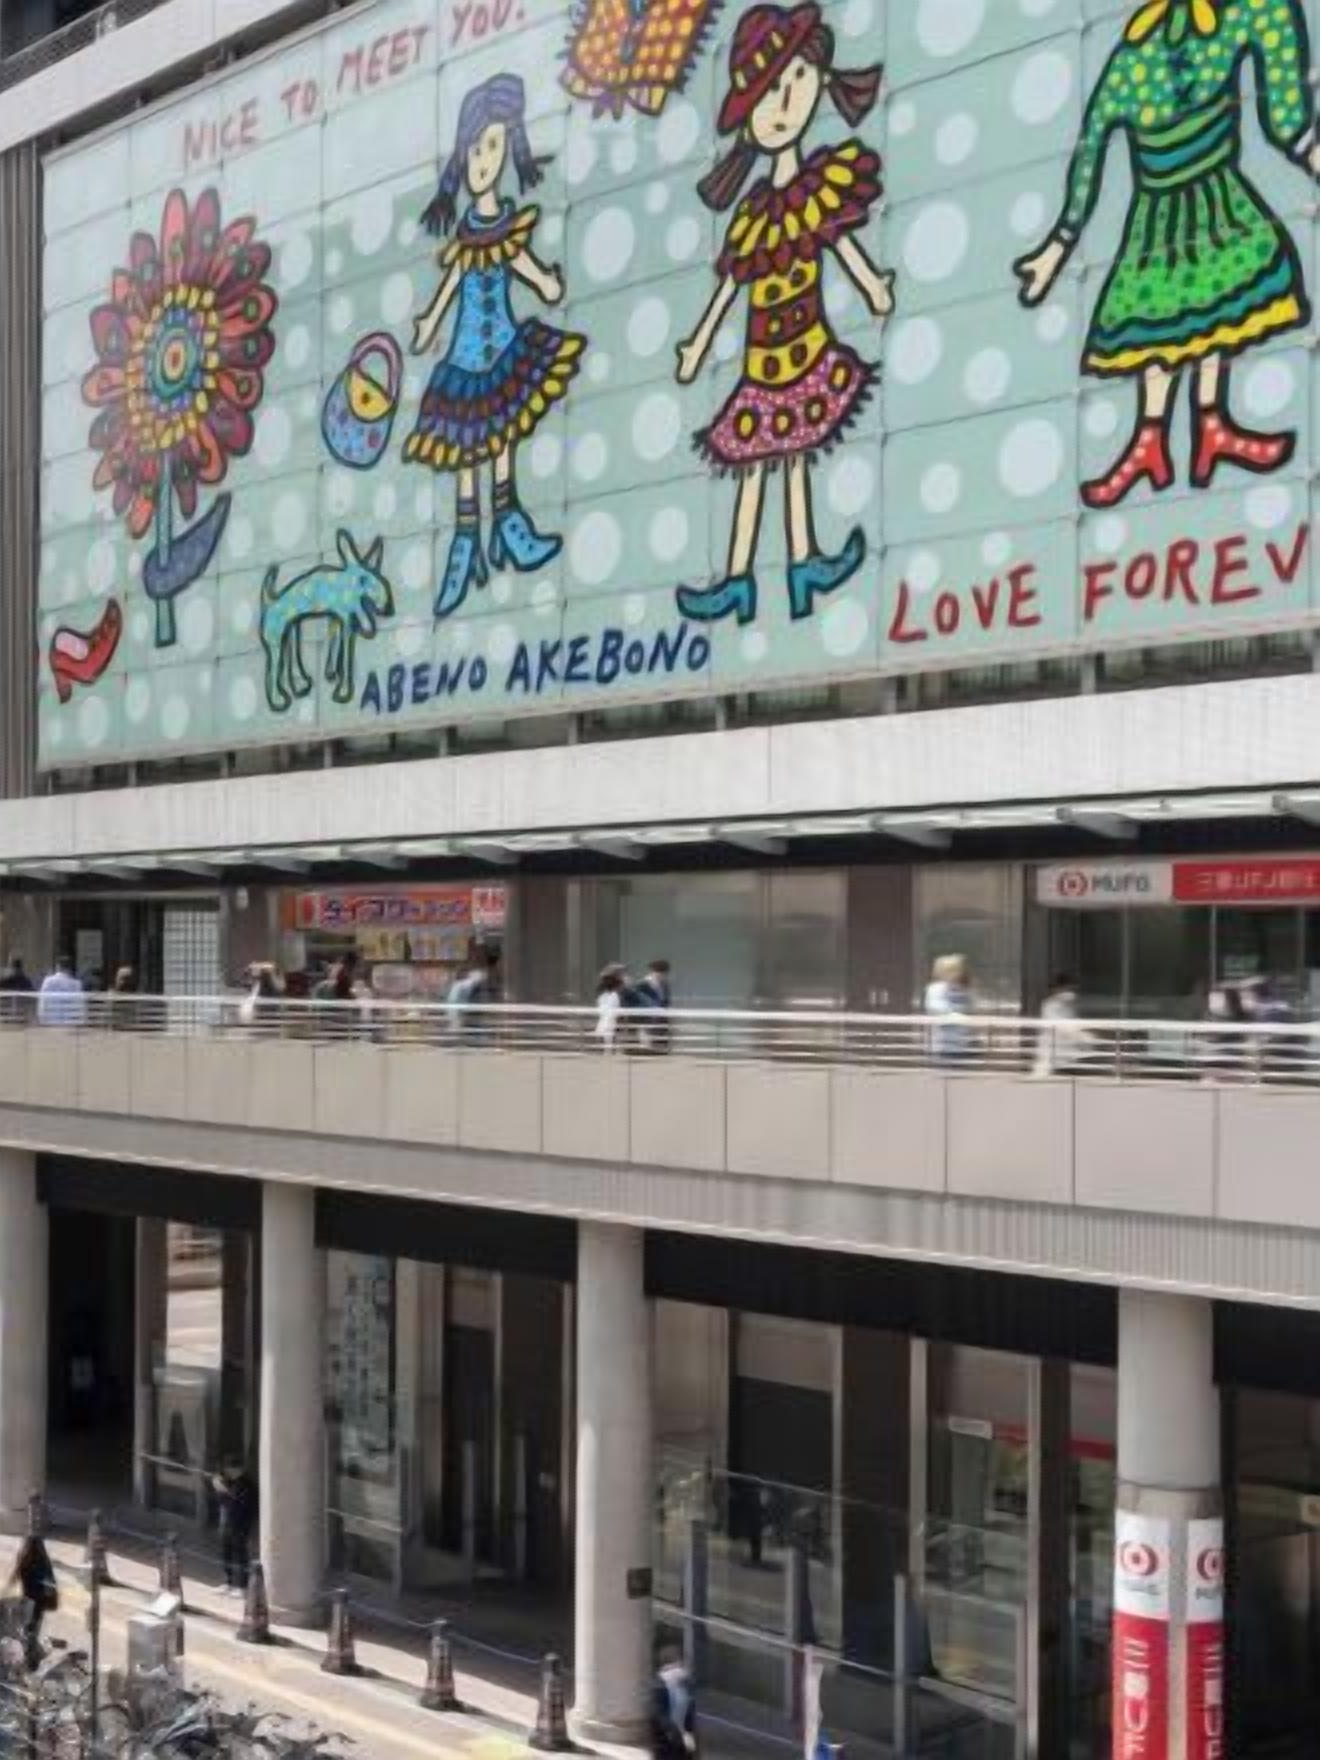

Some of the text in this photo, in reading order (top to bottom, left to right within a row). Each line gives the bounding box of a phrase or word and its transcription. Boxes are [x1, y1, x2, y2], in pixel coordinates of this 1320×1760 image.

[183, 98, 258, 166] NICE
[282, 79, 318, 121] TO
[338, 25, 429, 93] MEET
[888, 523, 1310, 643] LOVE FOREV
[360, 622, 712, 714] ABENO AKEBONO
